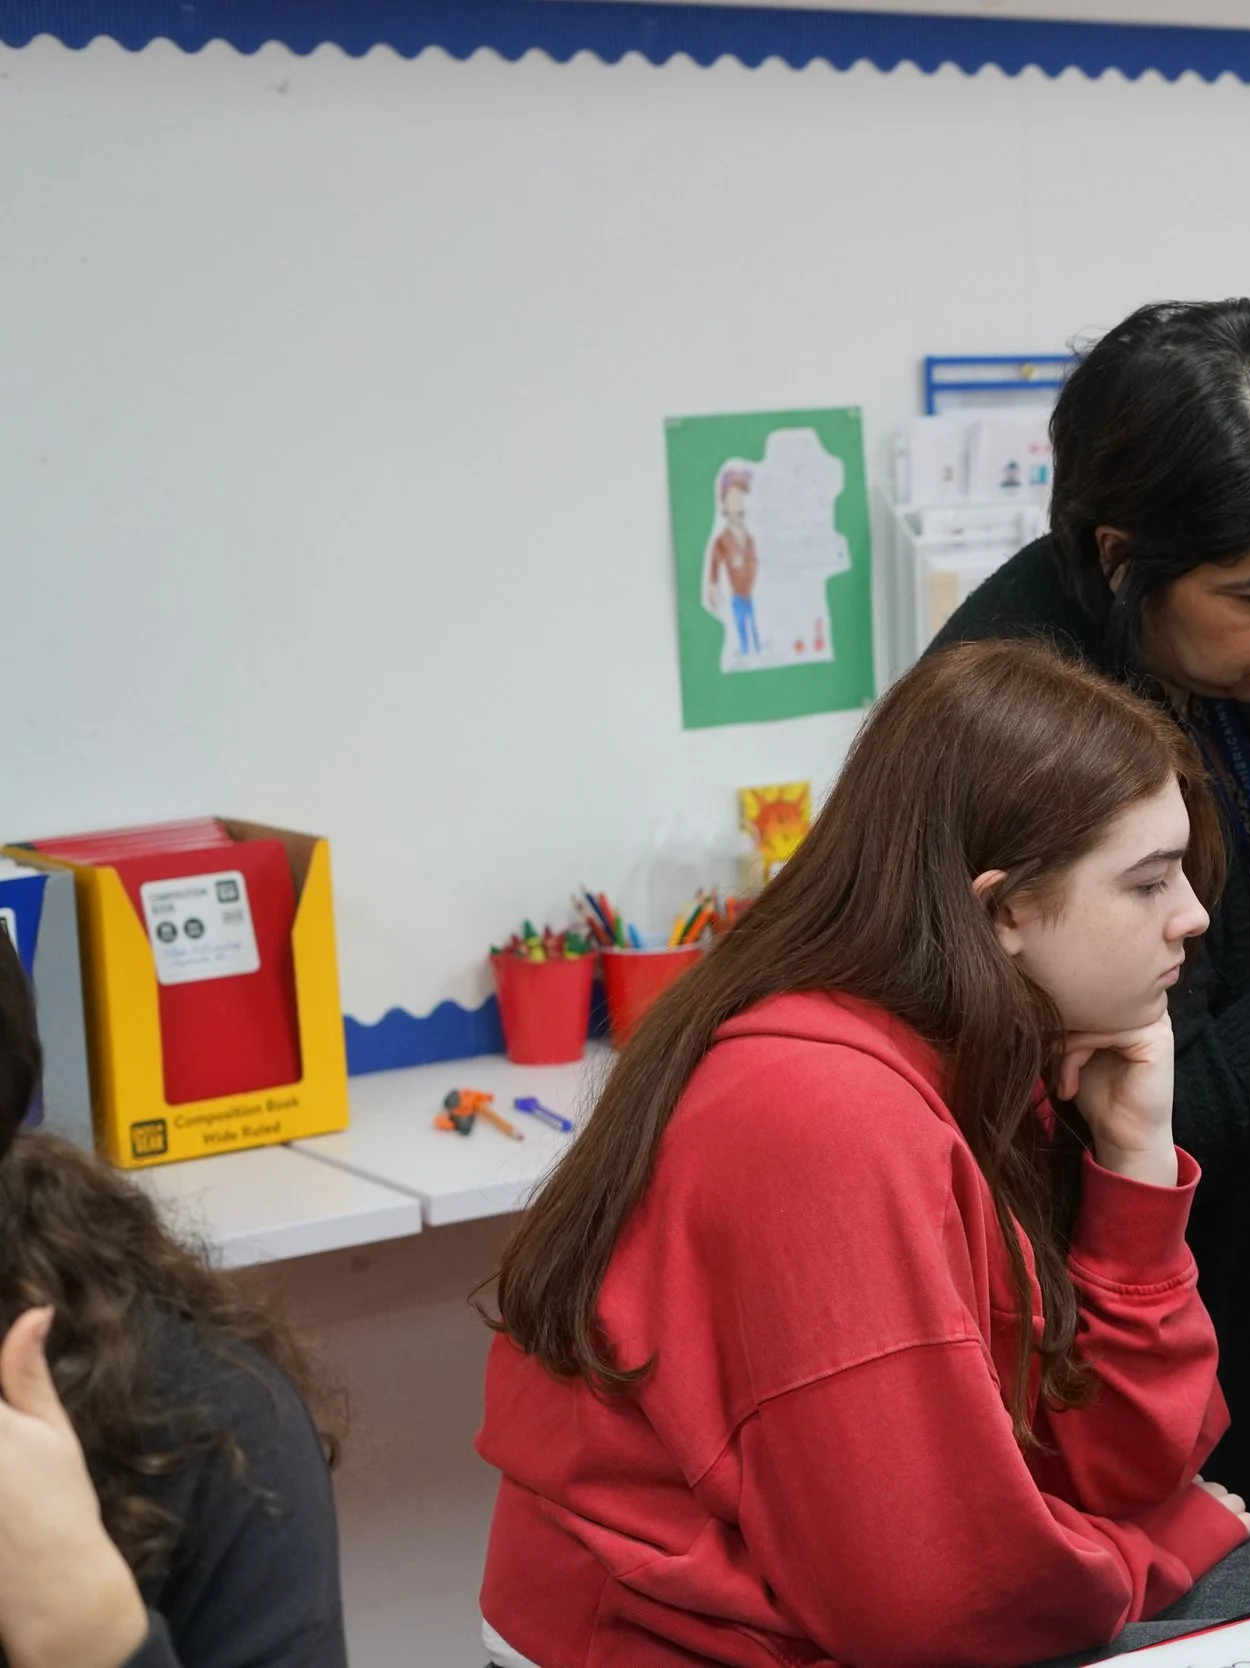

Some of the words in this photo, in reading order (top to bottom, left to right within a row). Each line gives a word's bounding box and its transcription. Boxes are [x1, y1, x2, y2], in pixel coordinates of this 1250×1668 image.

[173, 1105, 262, 1130] Composition
[265, 1096, 299, 1113] Book
[202, 1129, 238, 1146] Wide
[241, 1121, 281, 1138] Ruled
